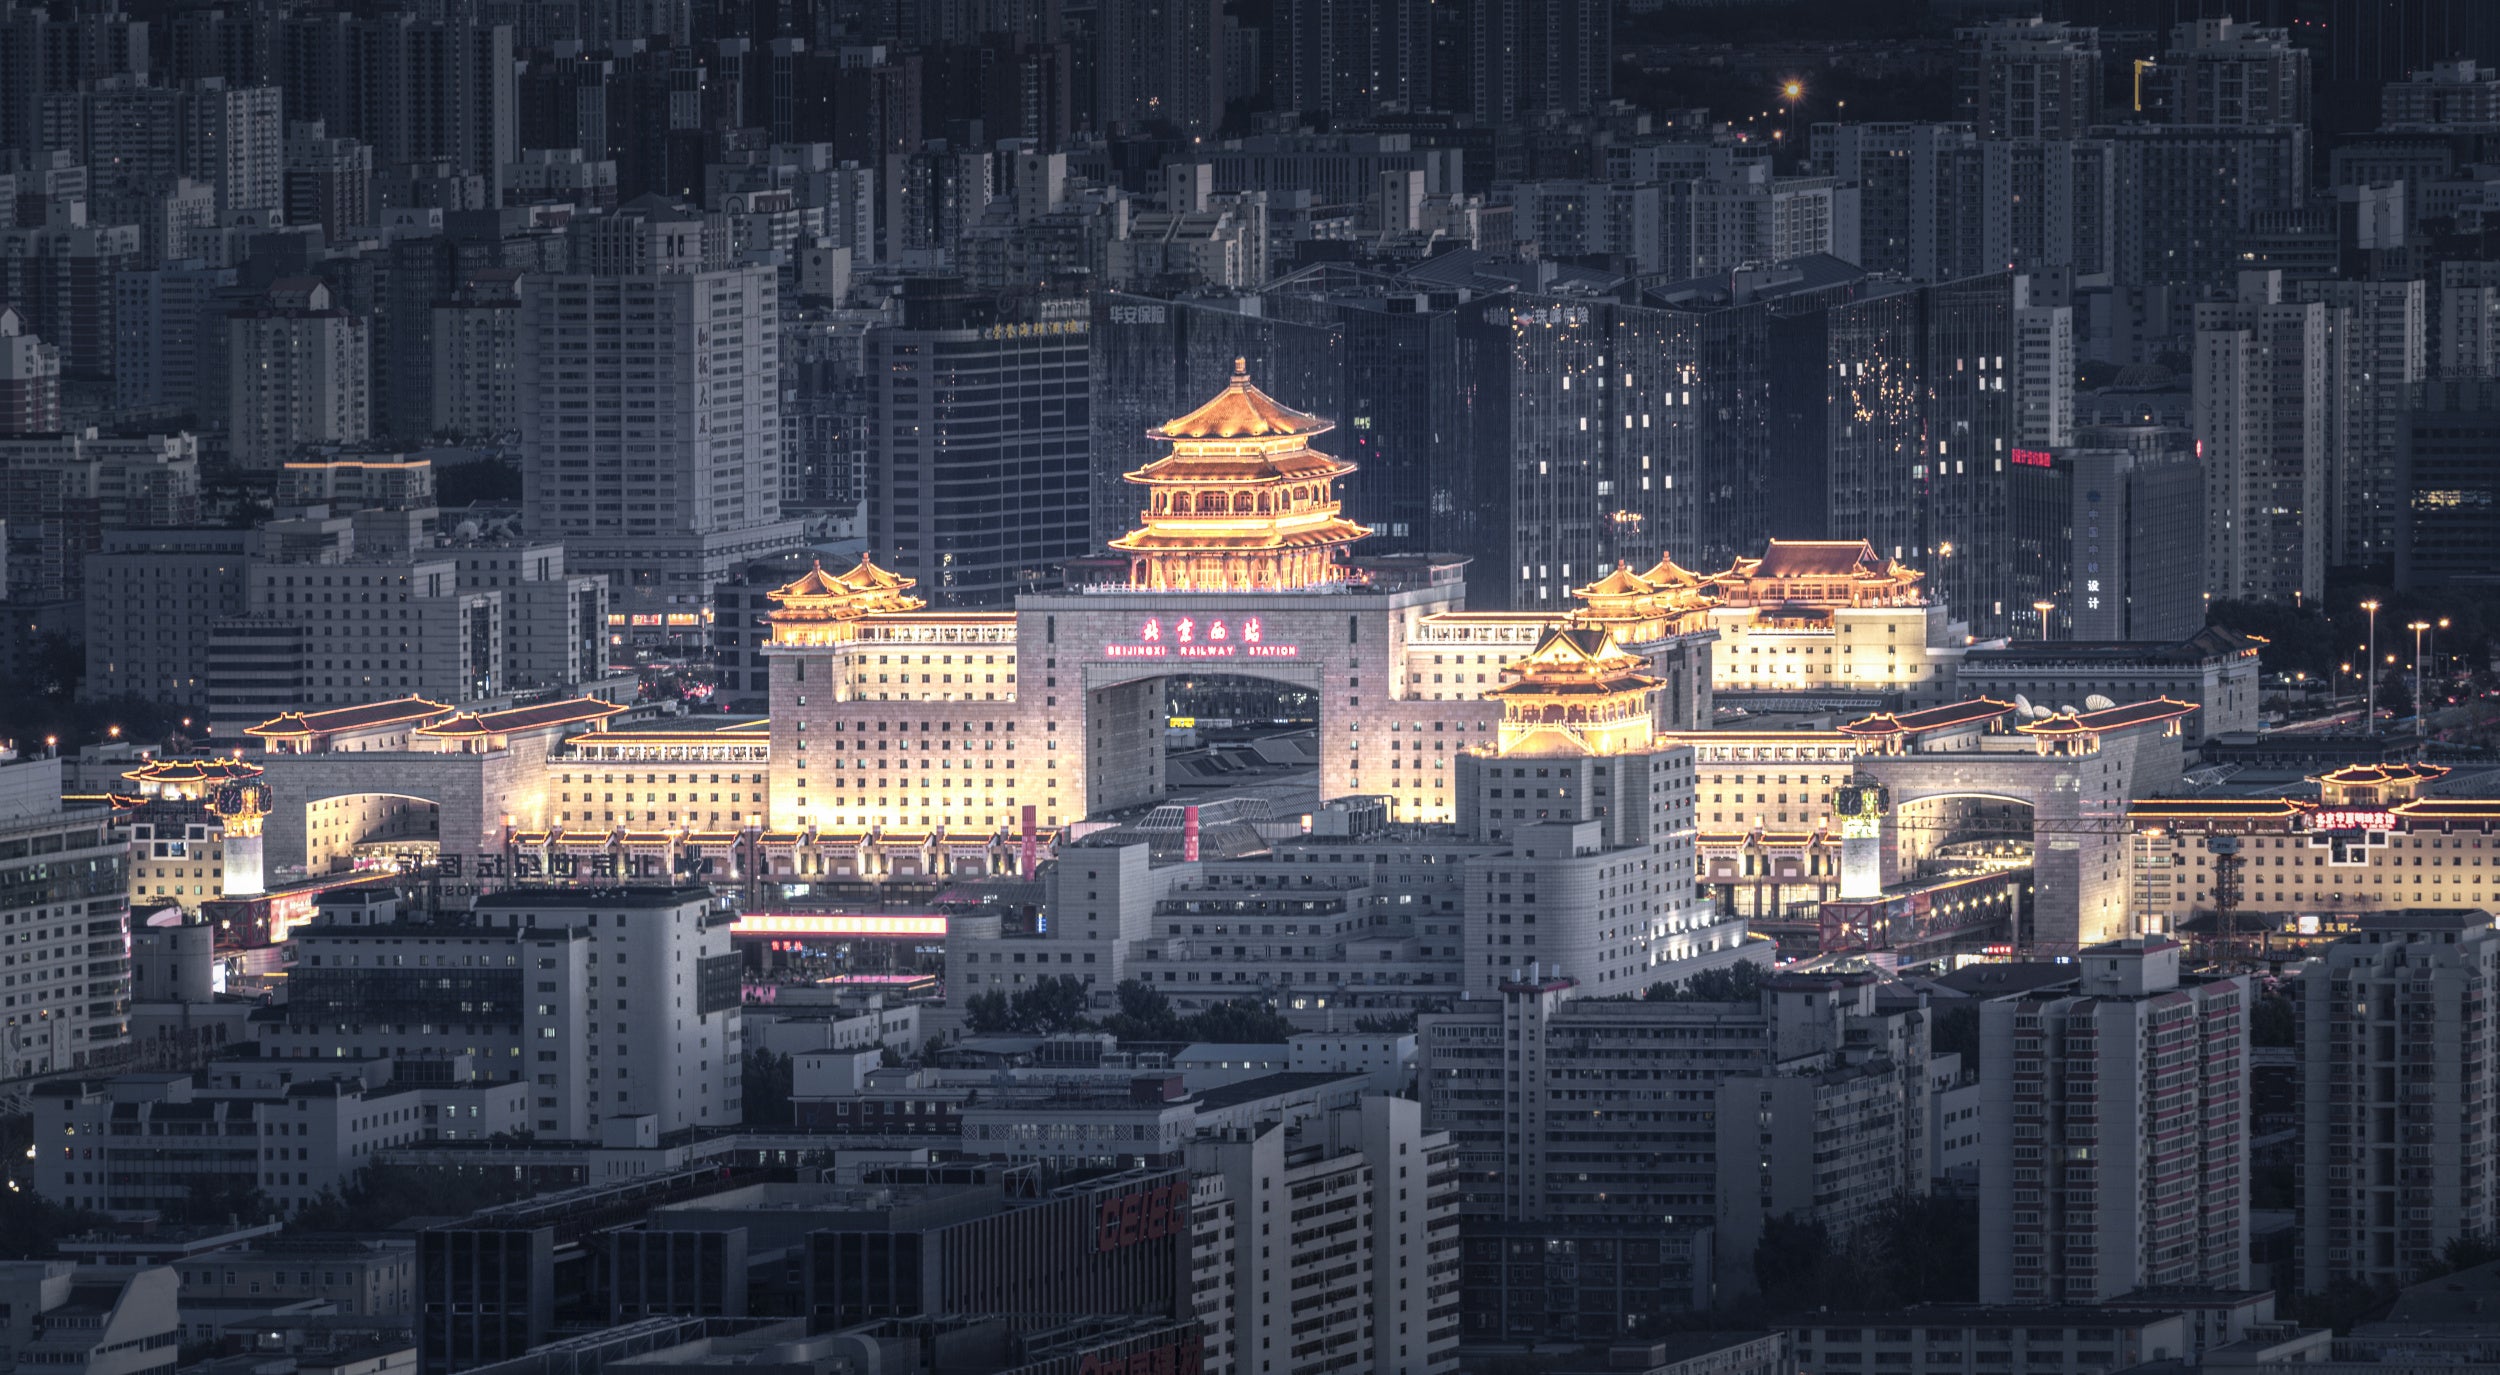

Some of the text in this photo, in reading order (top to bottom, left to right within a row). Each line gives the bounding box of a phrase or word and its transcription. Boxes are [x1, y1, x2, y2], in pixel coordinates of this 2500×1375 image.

[1109, 305, 1166, 325] 华安保险
[1143, 617, 1260, 643] 北京西站
[1107, 646, 1296, 656] BEIJINGXI RAILWAY STATION
[1100, 1182, 1188, 1252] CEIEC
